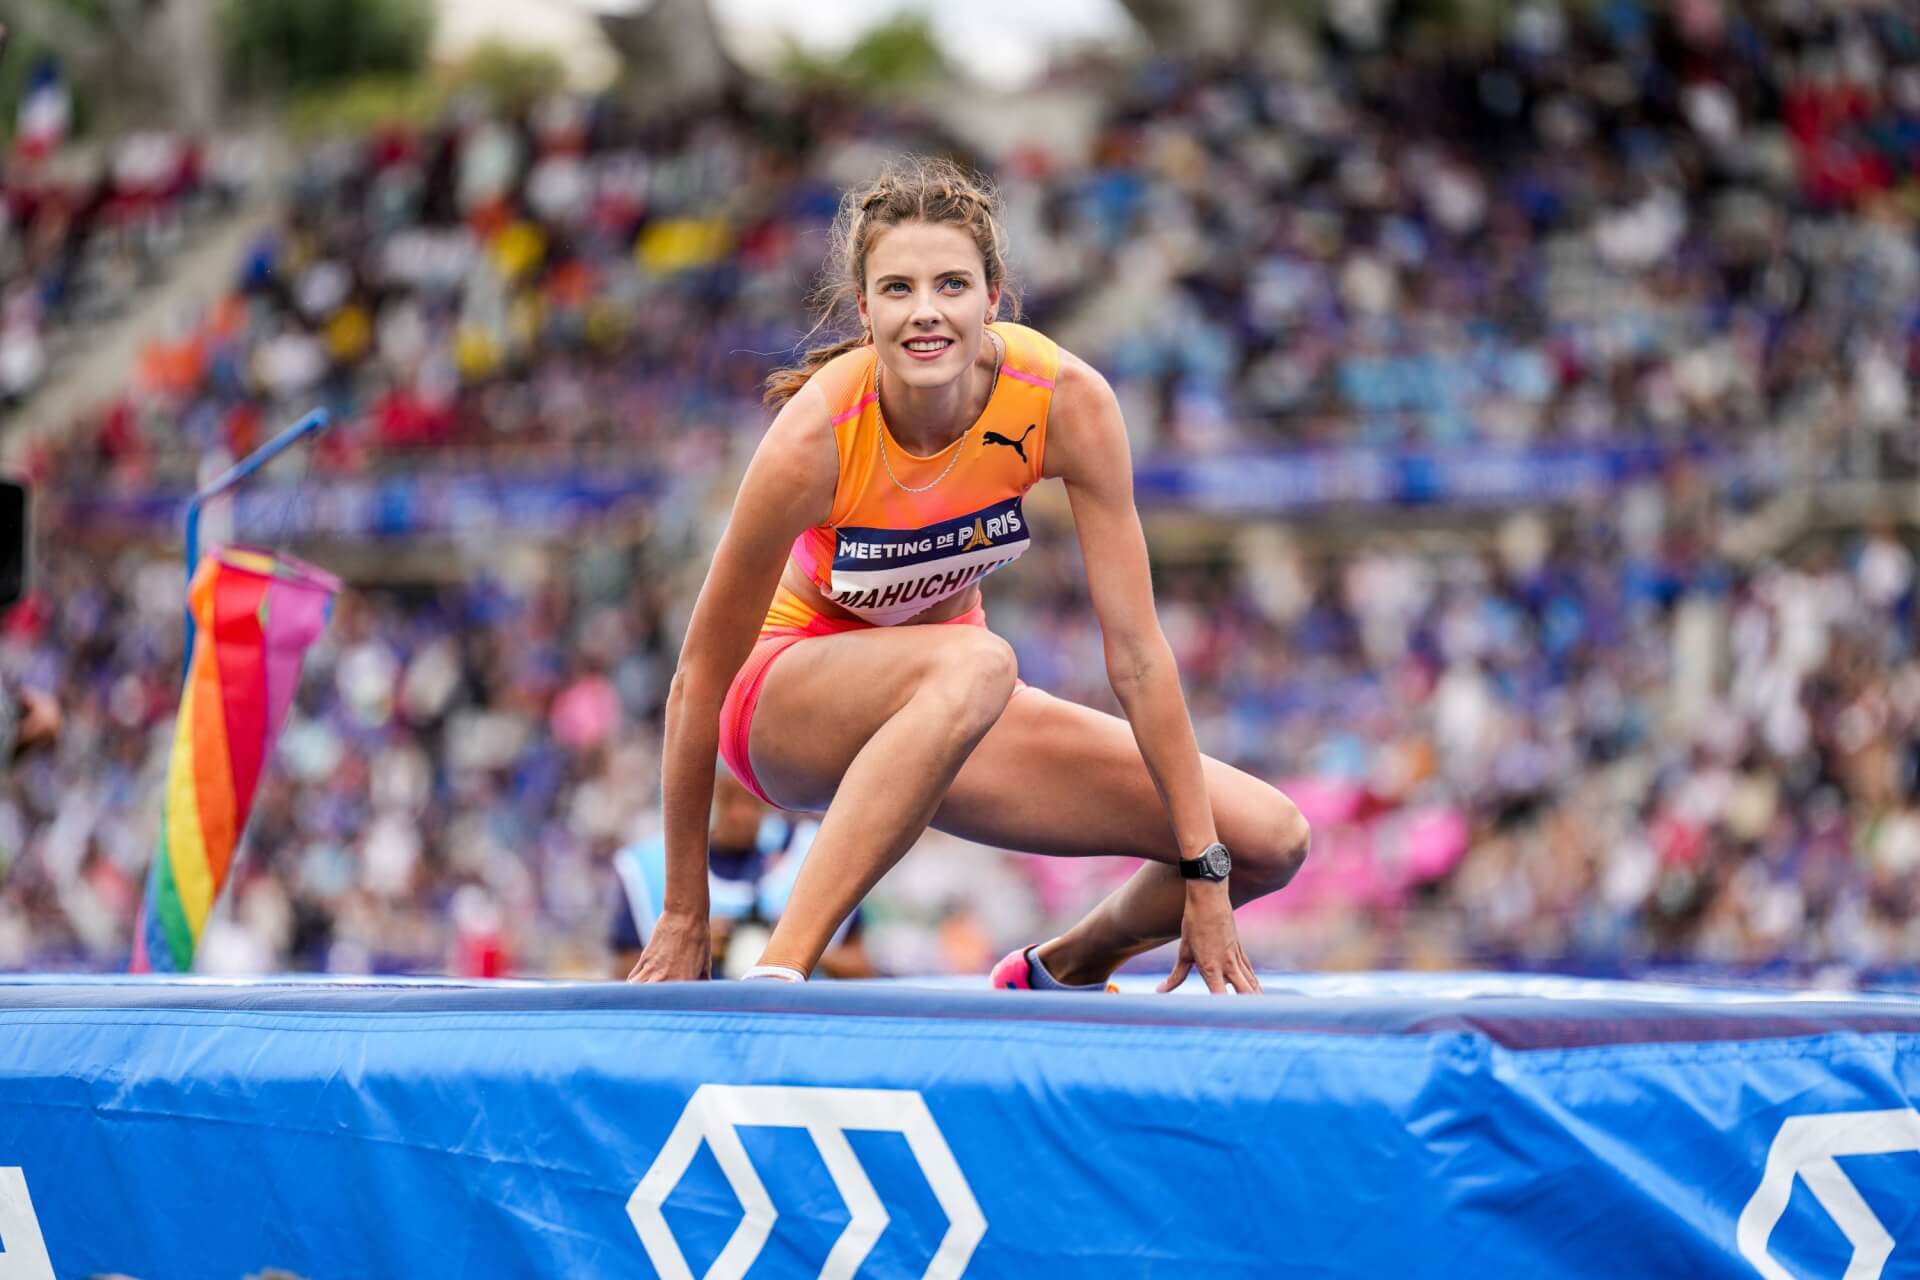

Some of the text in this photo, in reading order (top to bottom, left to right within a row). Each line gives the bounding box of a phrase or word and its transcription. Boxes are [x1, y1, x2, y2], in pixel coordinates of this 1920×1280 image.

[838, 510, 1021, 560] MEETING DE PARIS
[833, 556, 1014, 609] MAHUCHIK
